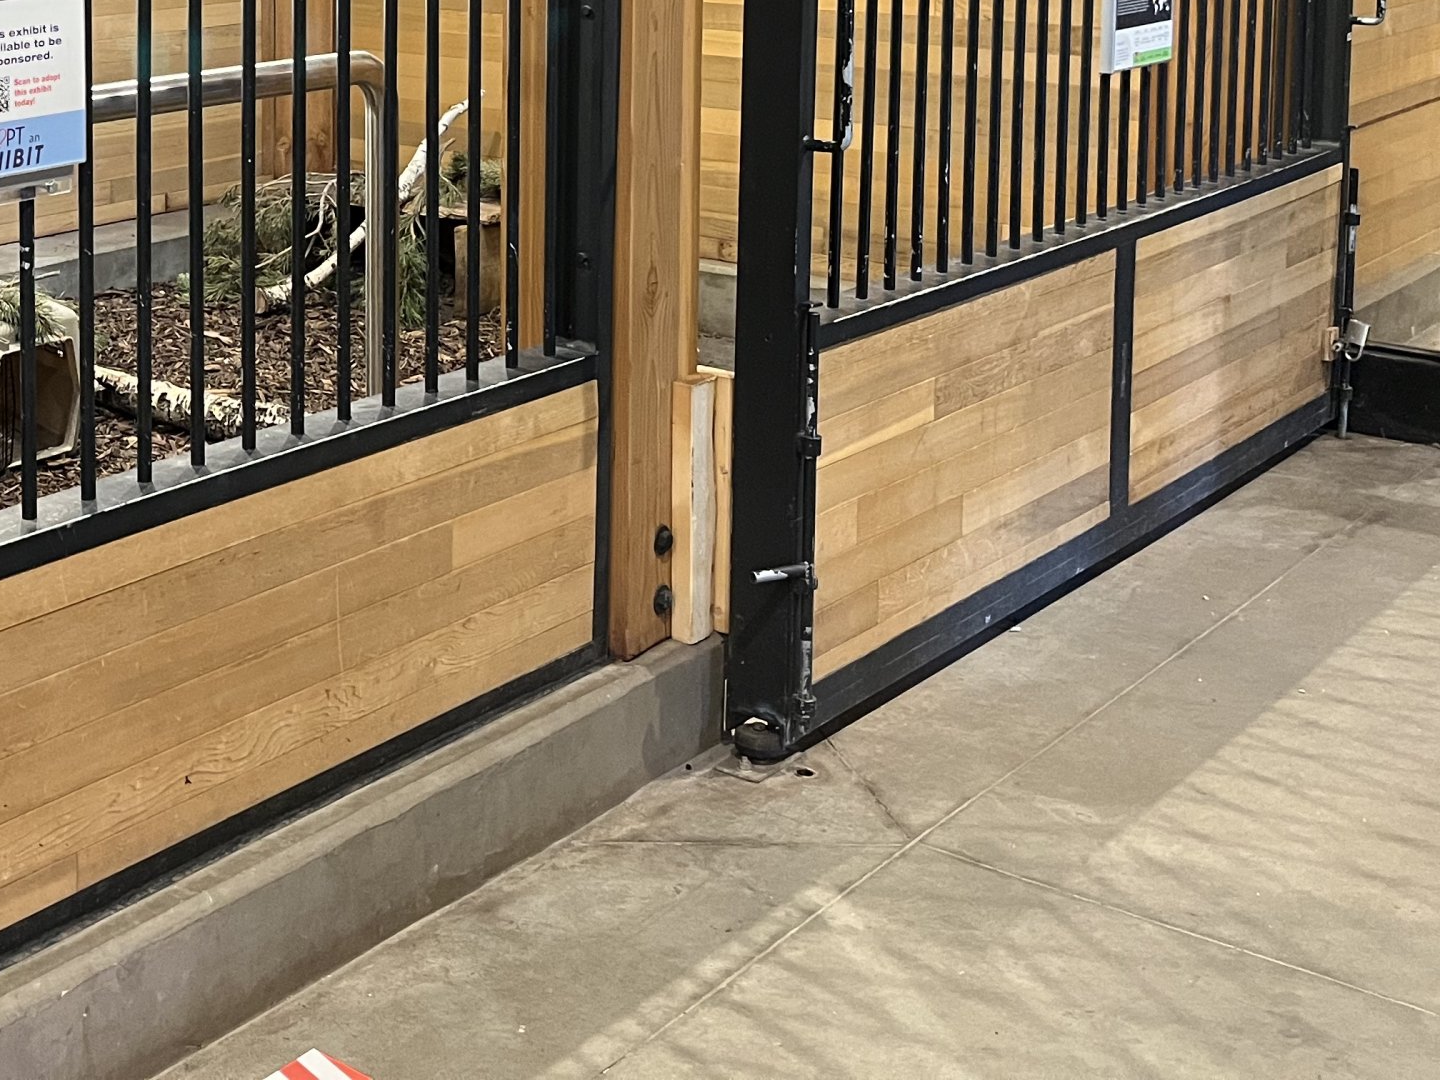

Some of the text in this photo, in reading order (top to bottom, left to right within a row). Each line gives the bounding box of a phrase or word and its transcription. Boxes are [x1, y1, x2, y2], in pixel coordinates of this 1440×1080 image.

[8, 24, 47, 37] exhibit
[50, 23, 60, 32] is
[34, 39, 45, 48] to
[48, 37, 62, 46] be
[13, 77, 31, 86] Scan
[41, 73, 61, 83] adopt
[14, 84, 52, 96] this exhibit
[28, 134, 41, 143] an
